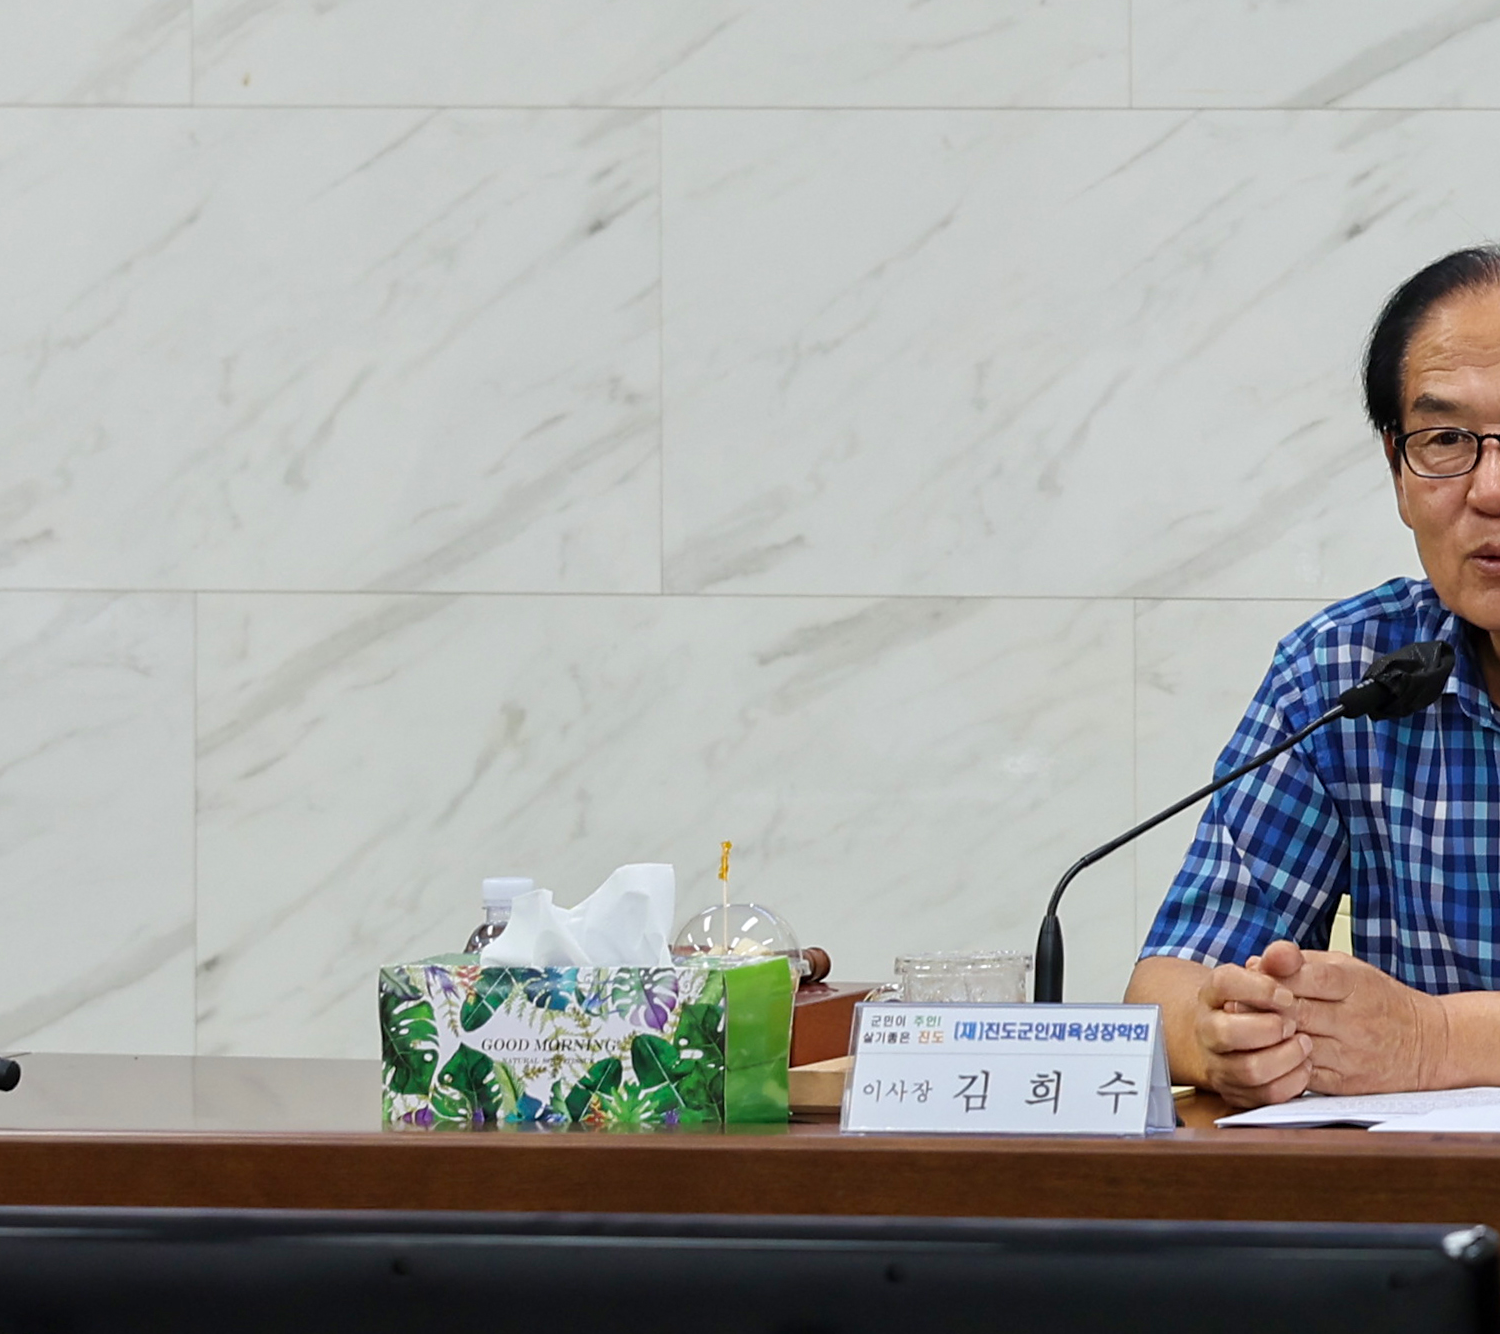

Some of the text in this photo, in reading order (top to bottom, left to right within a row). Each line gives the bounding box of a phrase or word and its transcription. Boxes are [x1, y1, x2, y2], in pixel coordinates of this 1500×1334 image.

[481, 1037, 617, 1052] GOOD MORNING
[918, 1030, 945, 1044] 진도
[862, 1079, 933, 1103] 이사장
